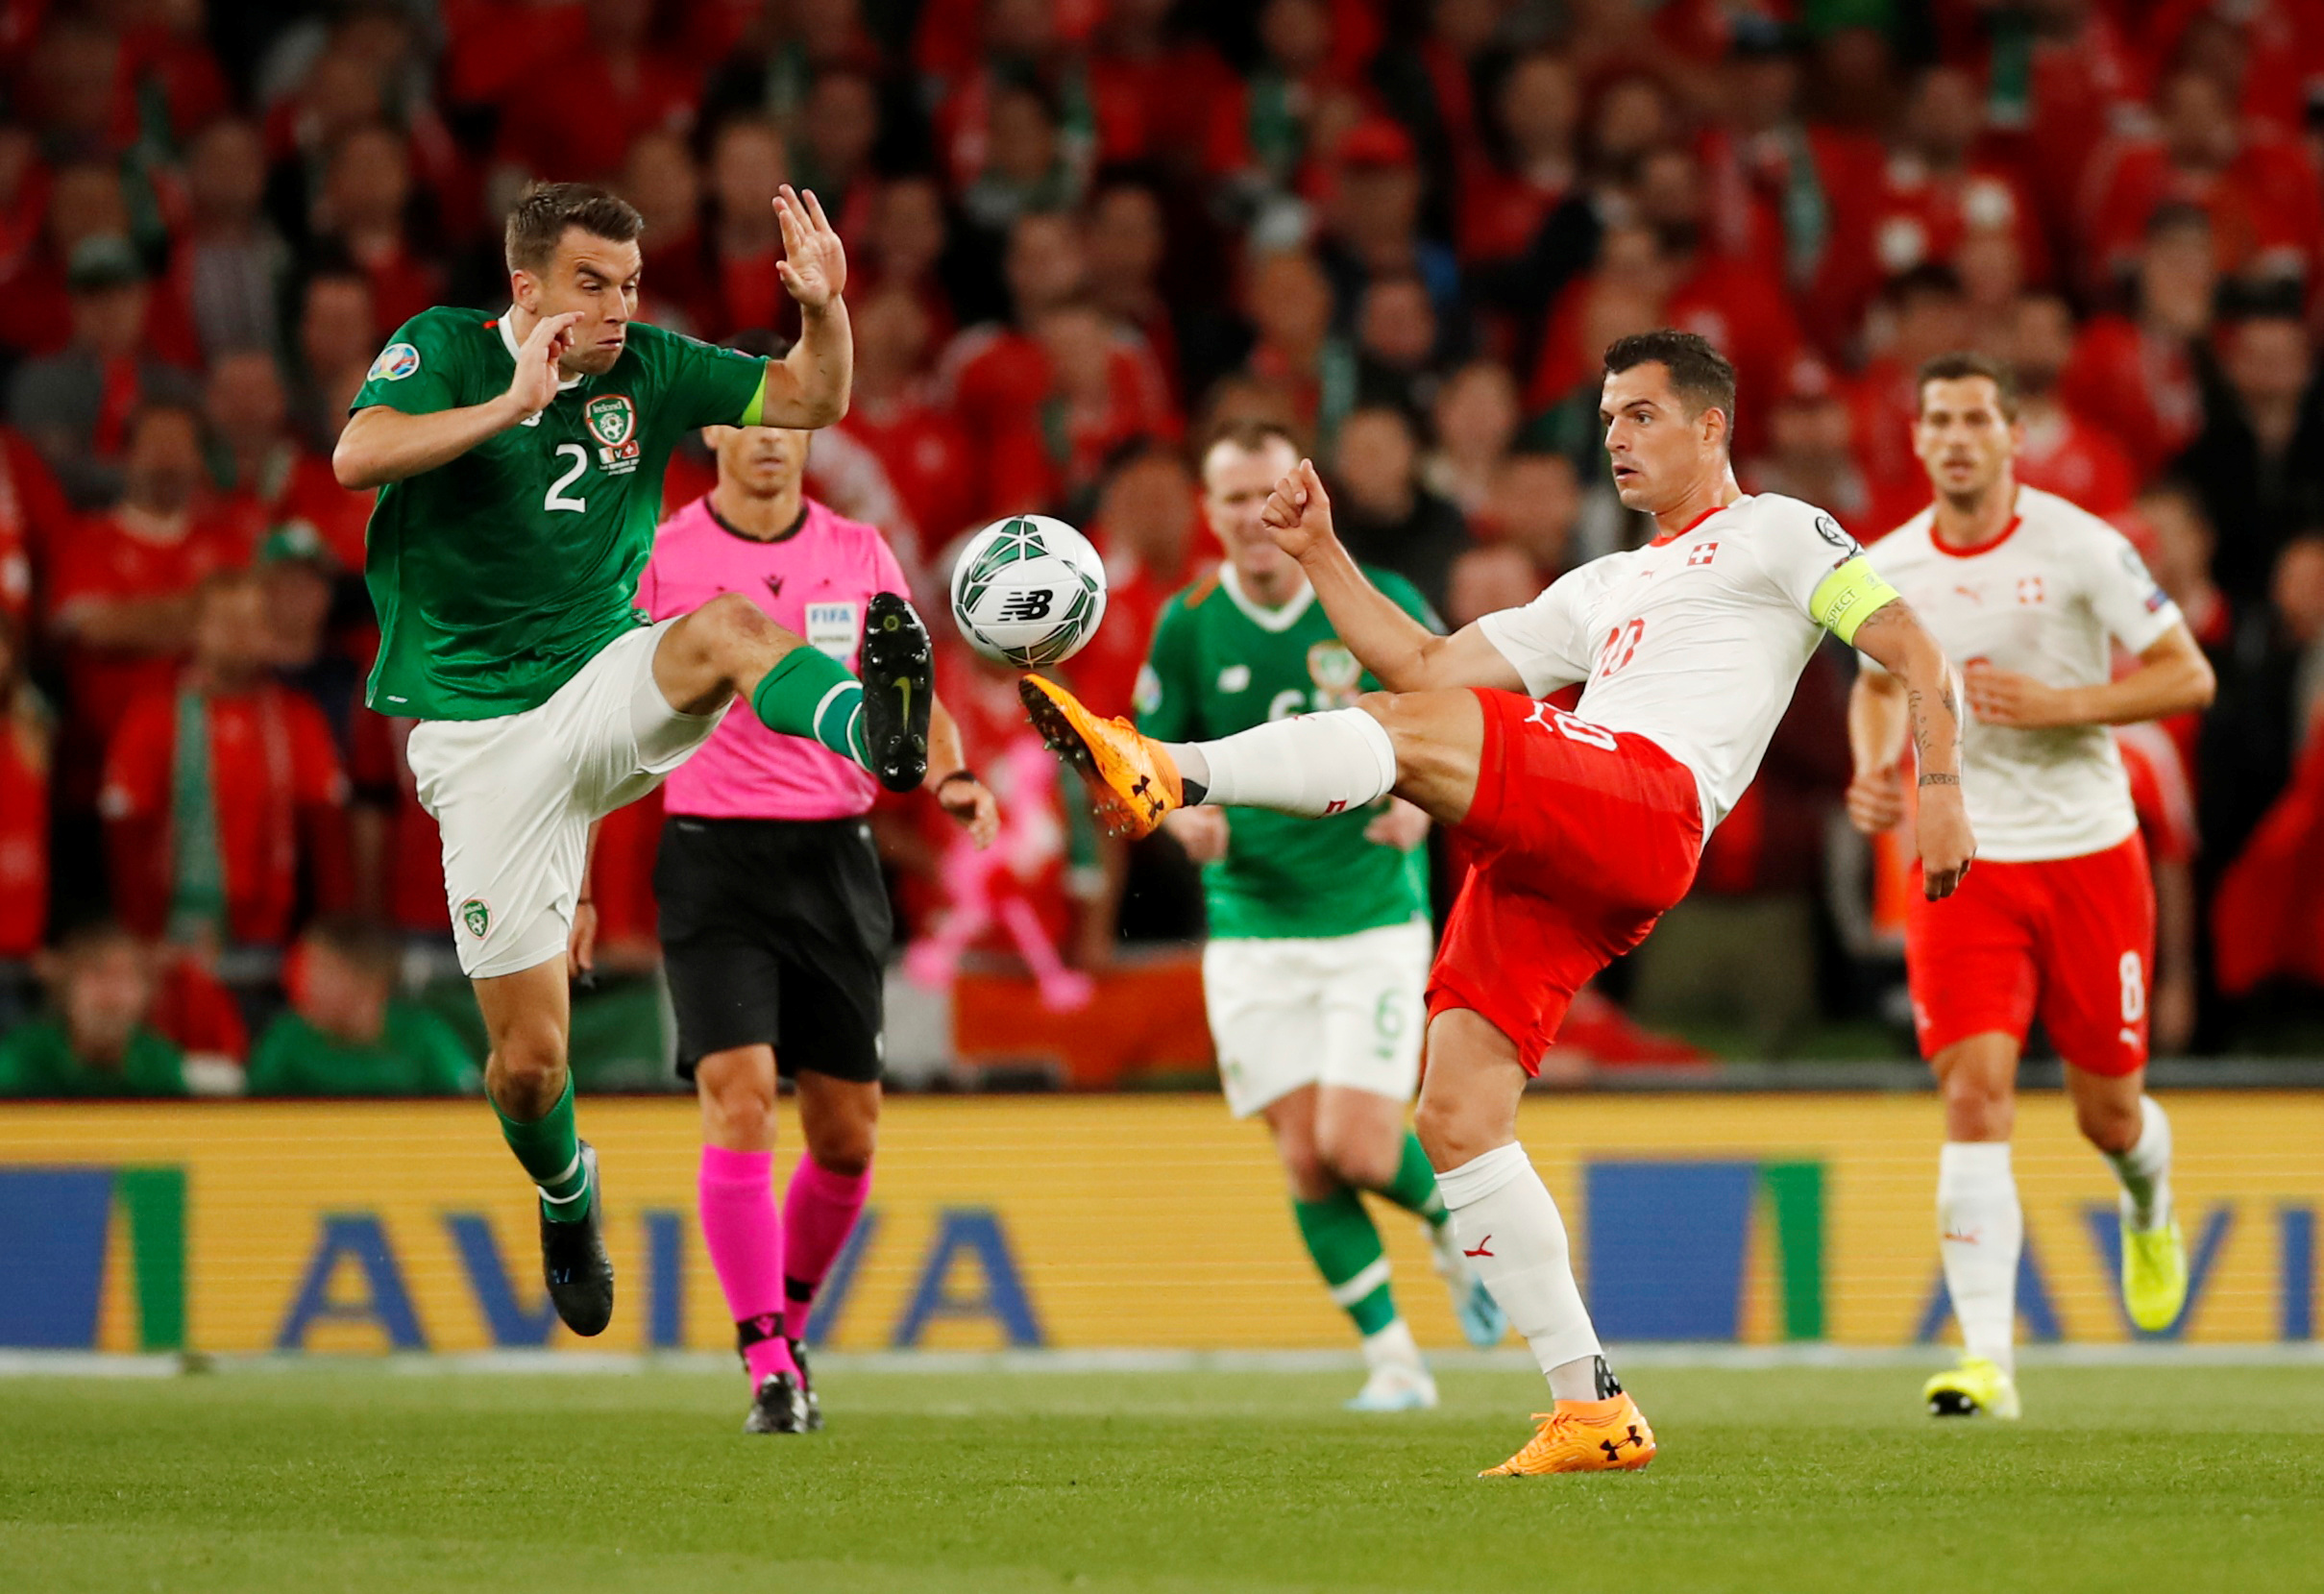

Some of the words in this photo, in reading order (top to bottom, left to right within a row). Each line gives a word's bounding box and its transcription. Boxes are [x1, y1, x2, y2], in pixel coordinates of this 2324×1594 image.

[545, 444, 588, 513] 2
[811, 607, 851, 624] FIFA
[1826, 588, 1856, 626] SPECT
[2118, 949, 2144, 1023] 8
[1373, 988, 1406, 1040] 6
